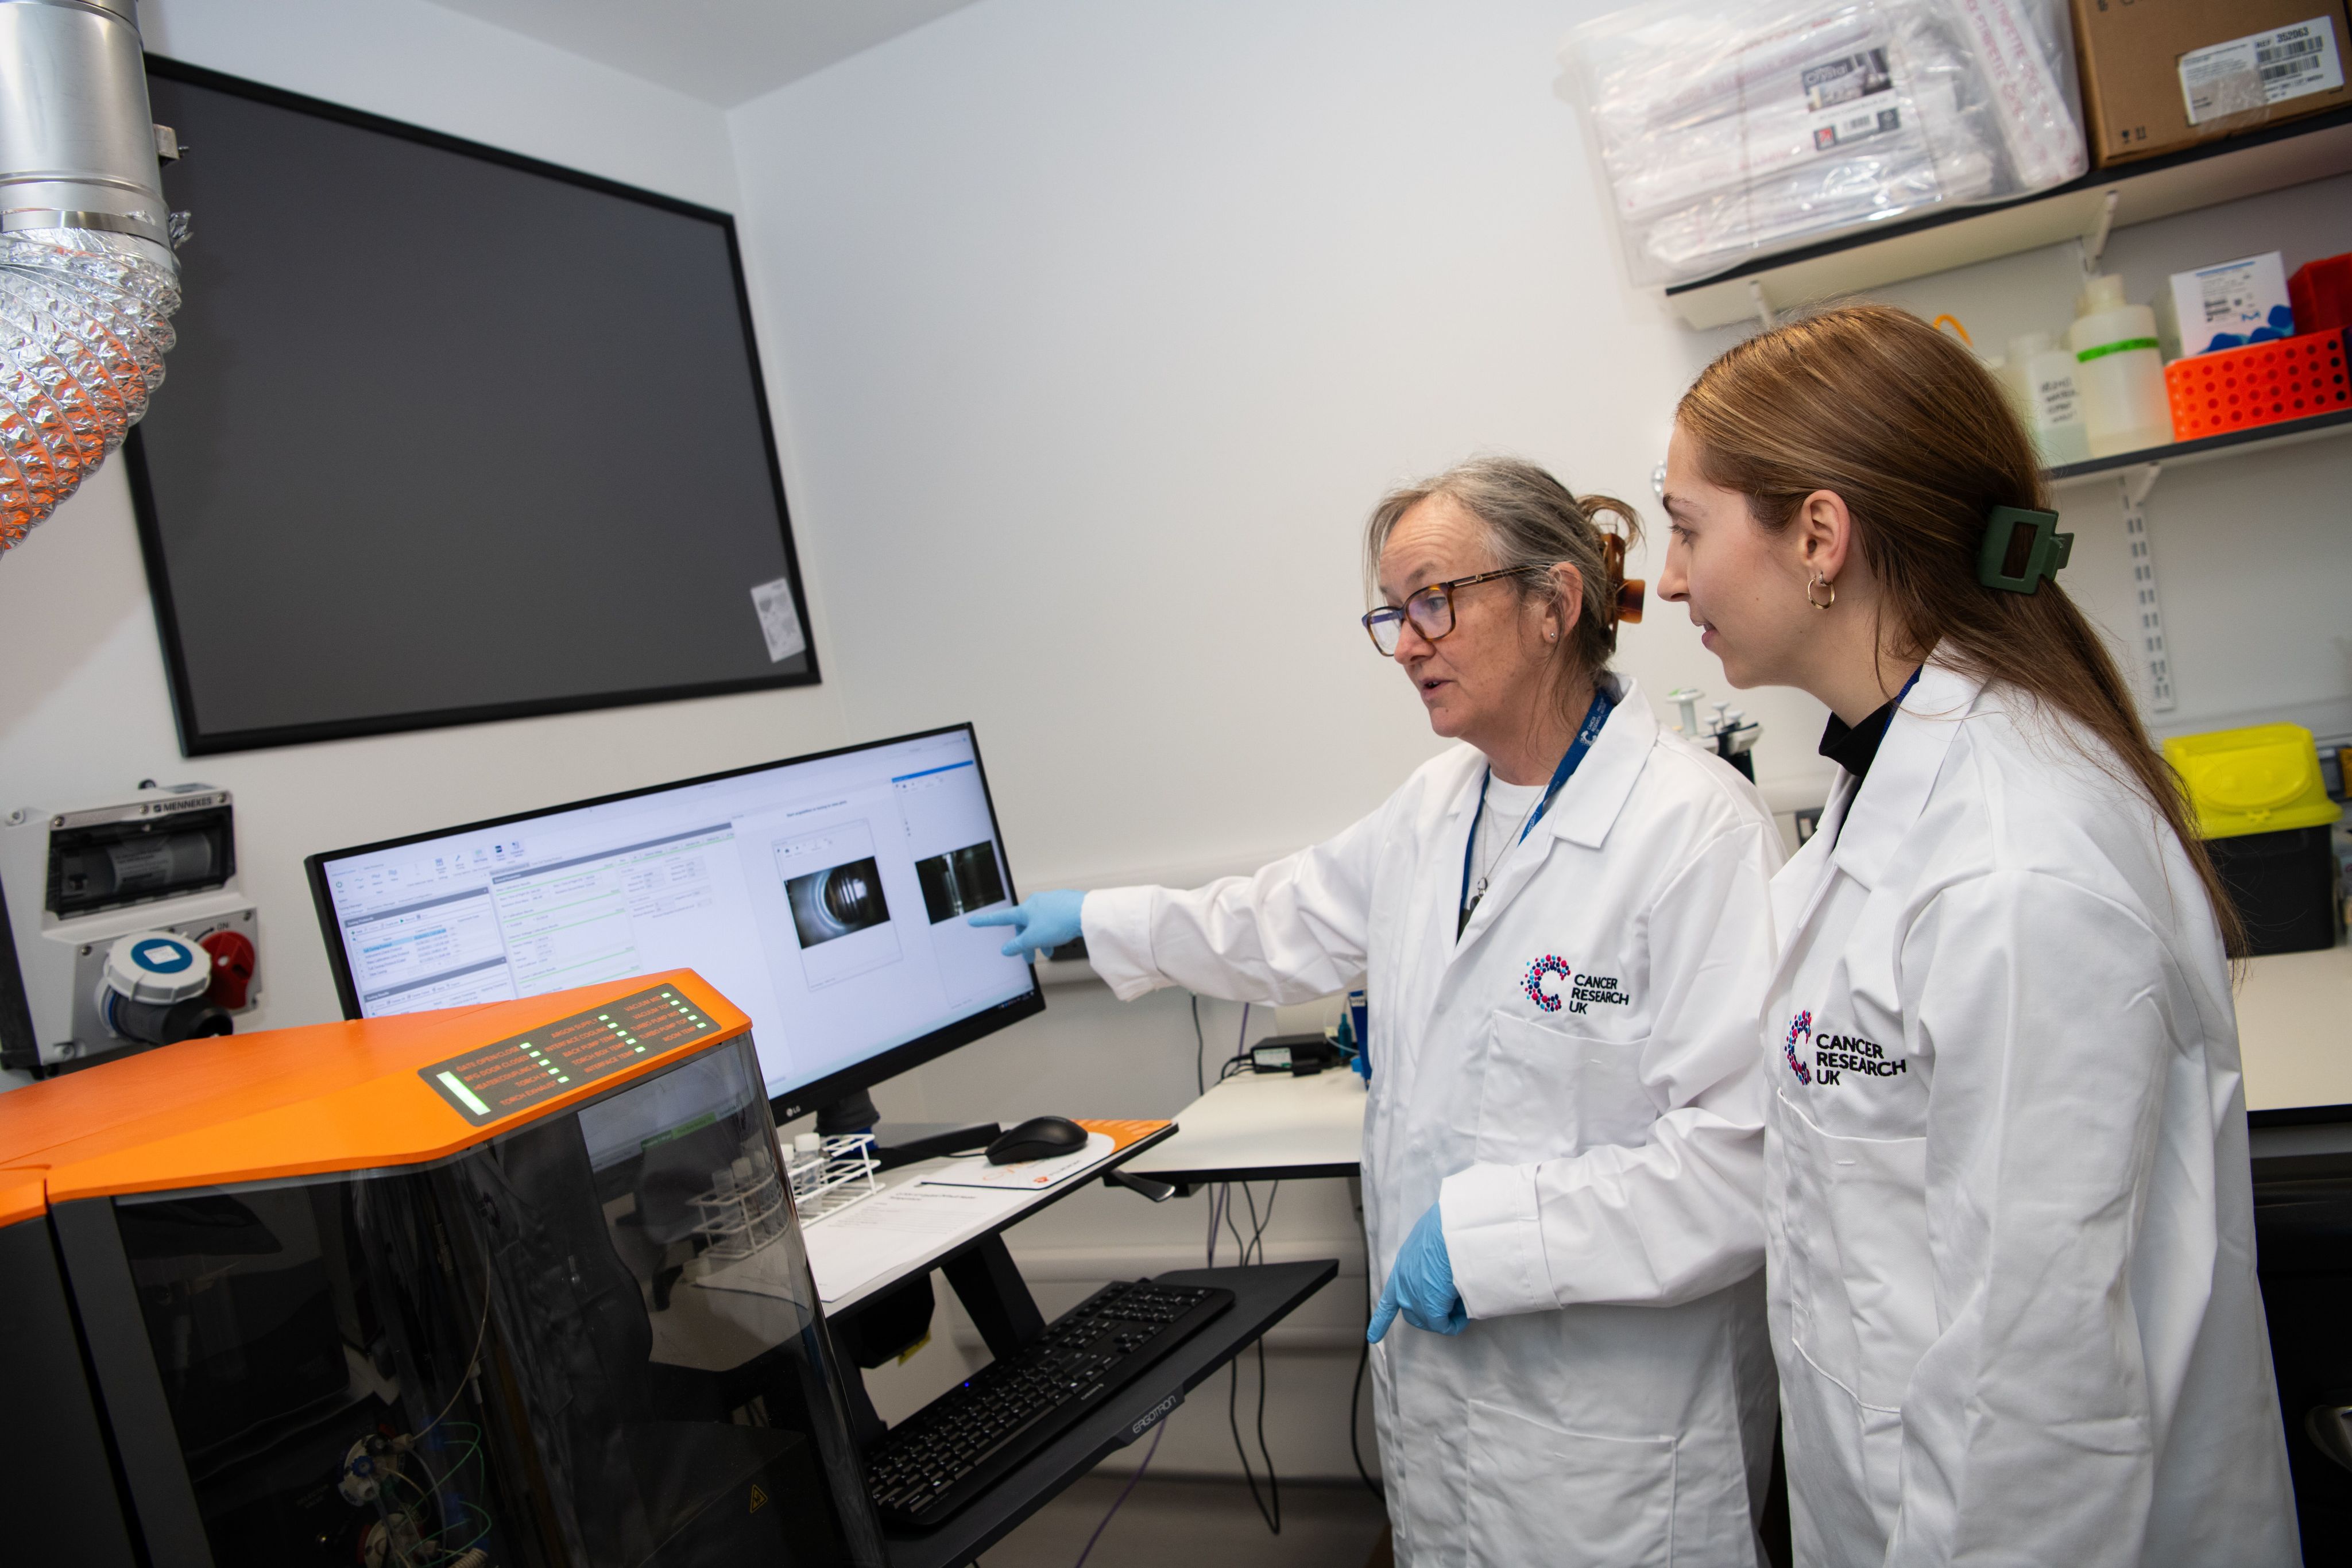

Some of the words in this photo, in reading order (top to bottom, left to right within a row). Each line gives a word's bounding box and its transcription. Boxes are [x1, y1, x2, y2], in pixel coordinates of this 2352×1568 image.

[163, 796, 212, 811] MENNEKES
[1574, 974, 1618, 990] CANCER
[1571, 987, 1629, 1005] RESEARCH
[624, 999, 651, 1011] VACUUM
[633, 1007, 659, 1019] VACUUM
[1569, 1000, 1588, 1015] UK
[544, 1036, 580, 1052] INTERFACE
[1816, 1033, 1884, 1059] CANCER
[583, 1056, 619, 1073] INTERFACE
[1816, 1051, 1906, 1077] RESEARCH
[1816, 1069, 1840, 1086] UK
[792, 1106, 800, 1114] LG
[1132, 1395, 1176, 1433] ERGOTRON
